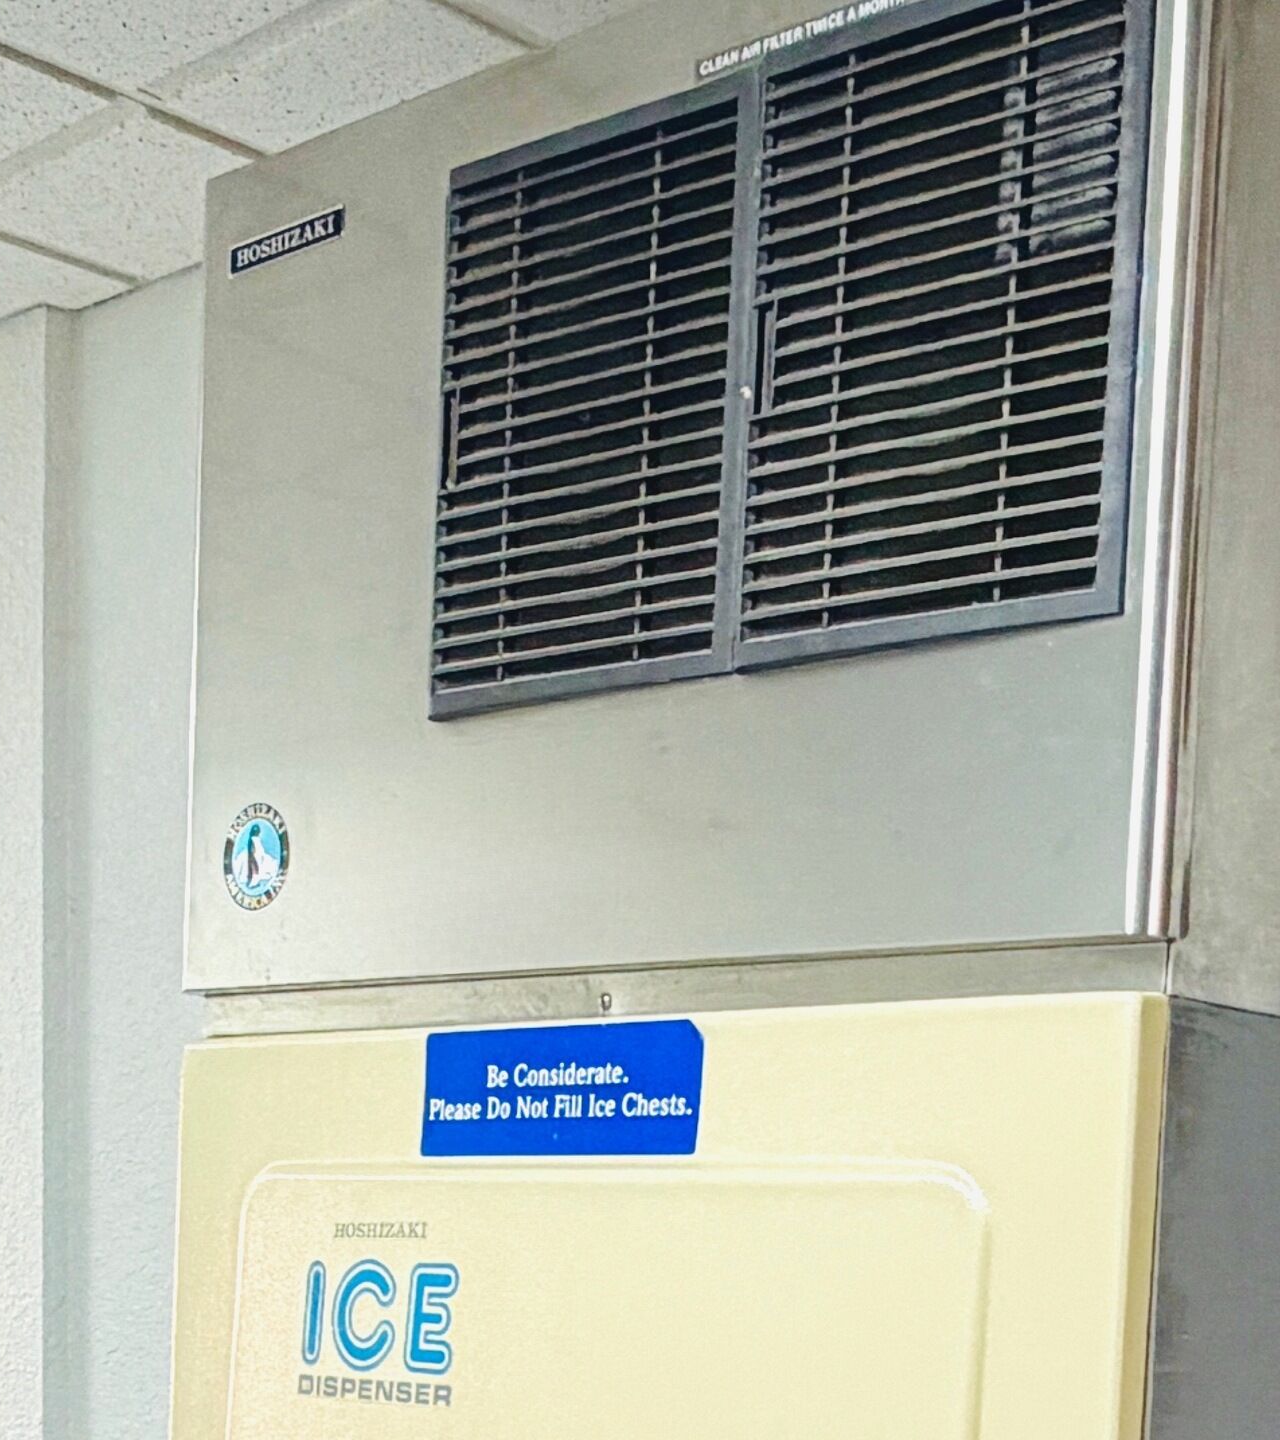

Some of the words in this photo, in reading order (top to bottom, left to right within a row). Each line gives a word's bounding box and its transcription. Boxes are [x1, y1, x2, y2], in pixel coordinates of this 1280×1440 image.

[700, 49, 739, 76] CLEAN
[741, 40, 761, 60] AIR
[763, 26, 804, 54] FILTER
[805, 10, 845, 38] TWICE
[847, 6, 856, 22] A
[236, 213, 337, 267] HOSHIZAKI
[486, 1064, 509, 1088] Be
[514, 1062, 629, 1087] Considerate.
[428, 1098, 482, 1121] Please
[486, 1096, 510, 1119] Do
[515, 1096, 548, 1118] Not
[553, 1094, 583, 1118] Fill
[588, 1093, 616, 1117] Ice
[621, 1092, 693, 1117] Chests.
[333, 1222, 428, 1239] HOSHIZAKI
[302, 1258, 460, 1375] ICE
[297, 1373, 453, 1407] DISPENSER
